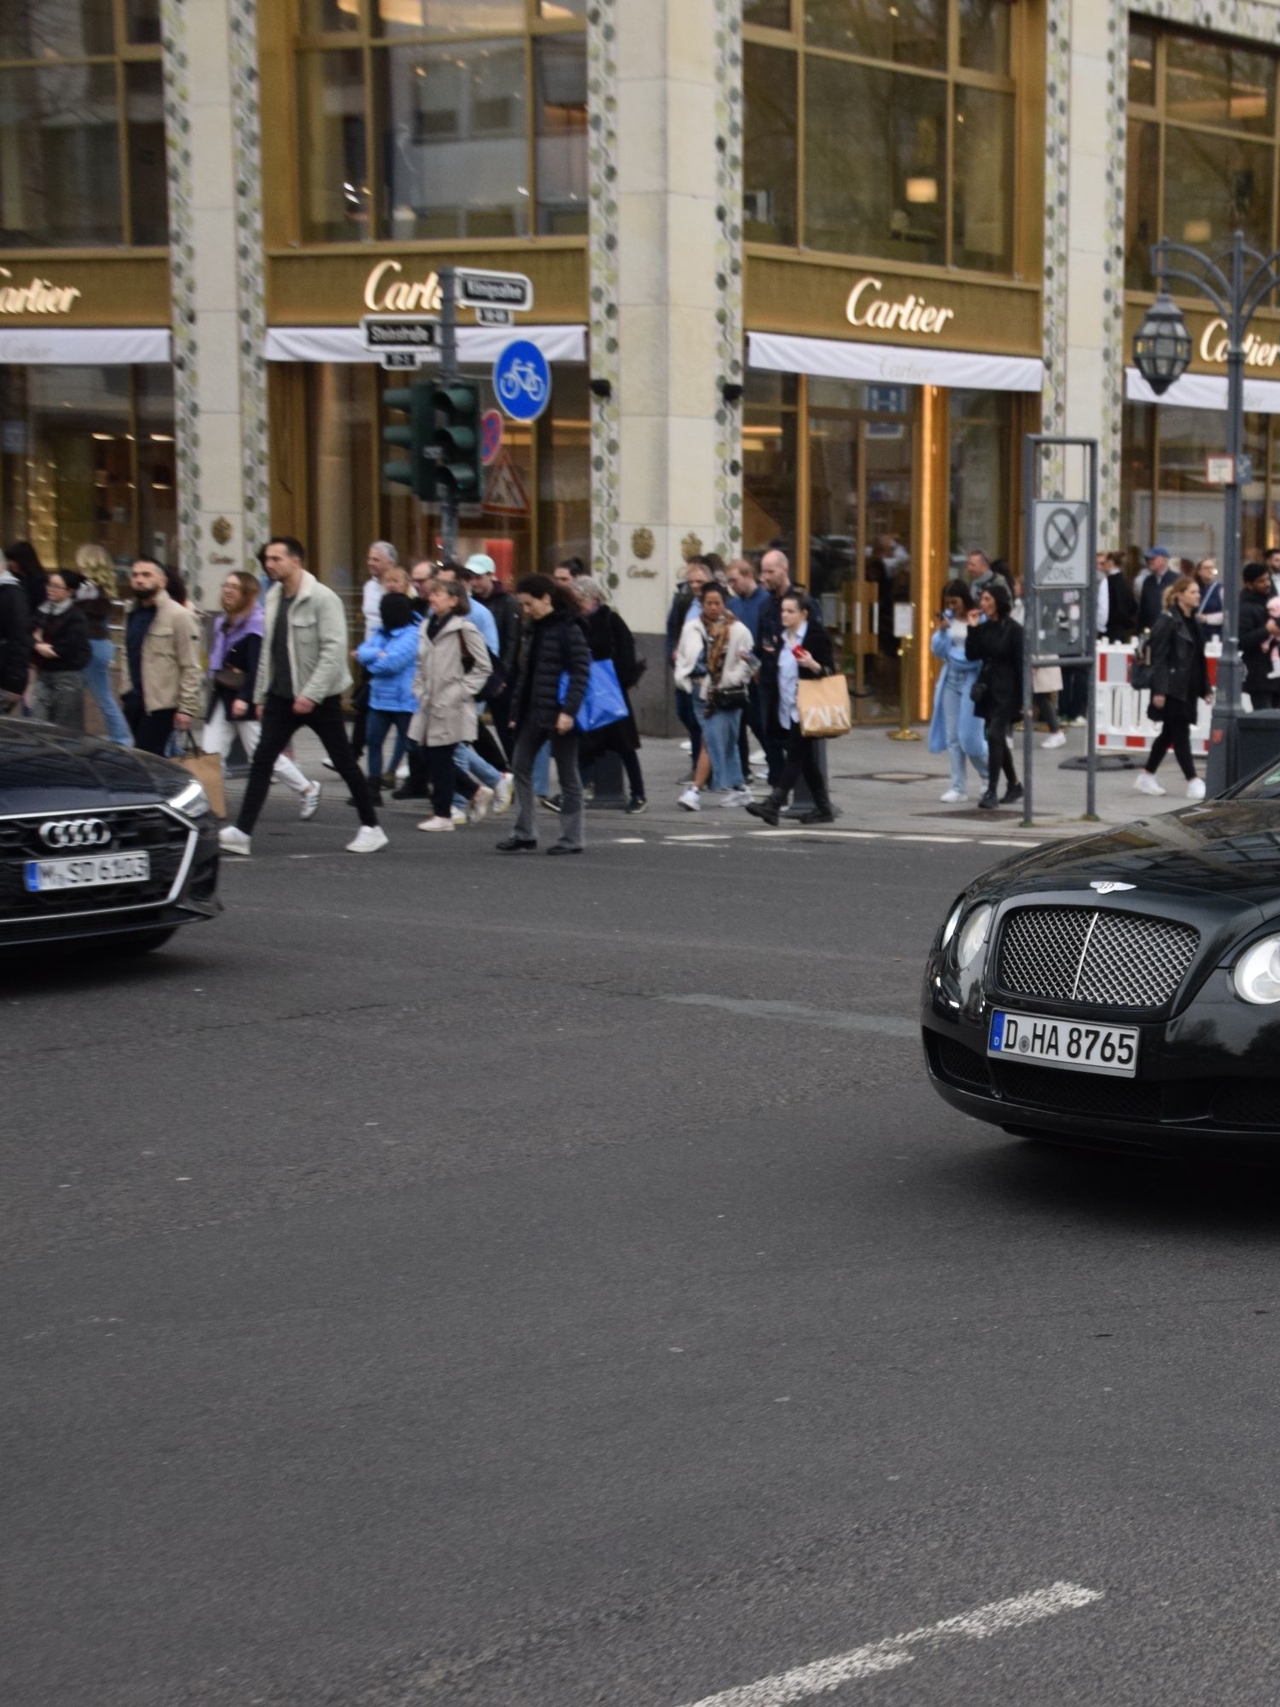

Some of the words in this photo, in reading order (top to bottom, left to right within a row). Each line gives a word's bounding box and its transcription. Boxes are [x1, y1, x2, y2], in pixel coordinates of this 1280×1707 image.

[0, 266, 82, 314] artier
[364, 260, 466, 312] Carti
[846, 276, 955, 334] Cartier
[1046, 566, 1075, 581] ZONE
[1004, 1019, 1018, 1050] D
[1030, 1022, 1059, 1056] HA
[1066, 1027, 1136, 1065] 8765
